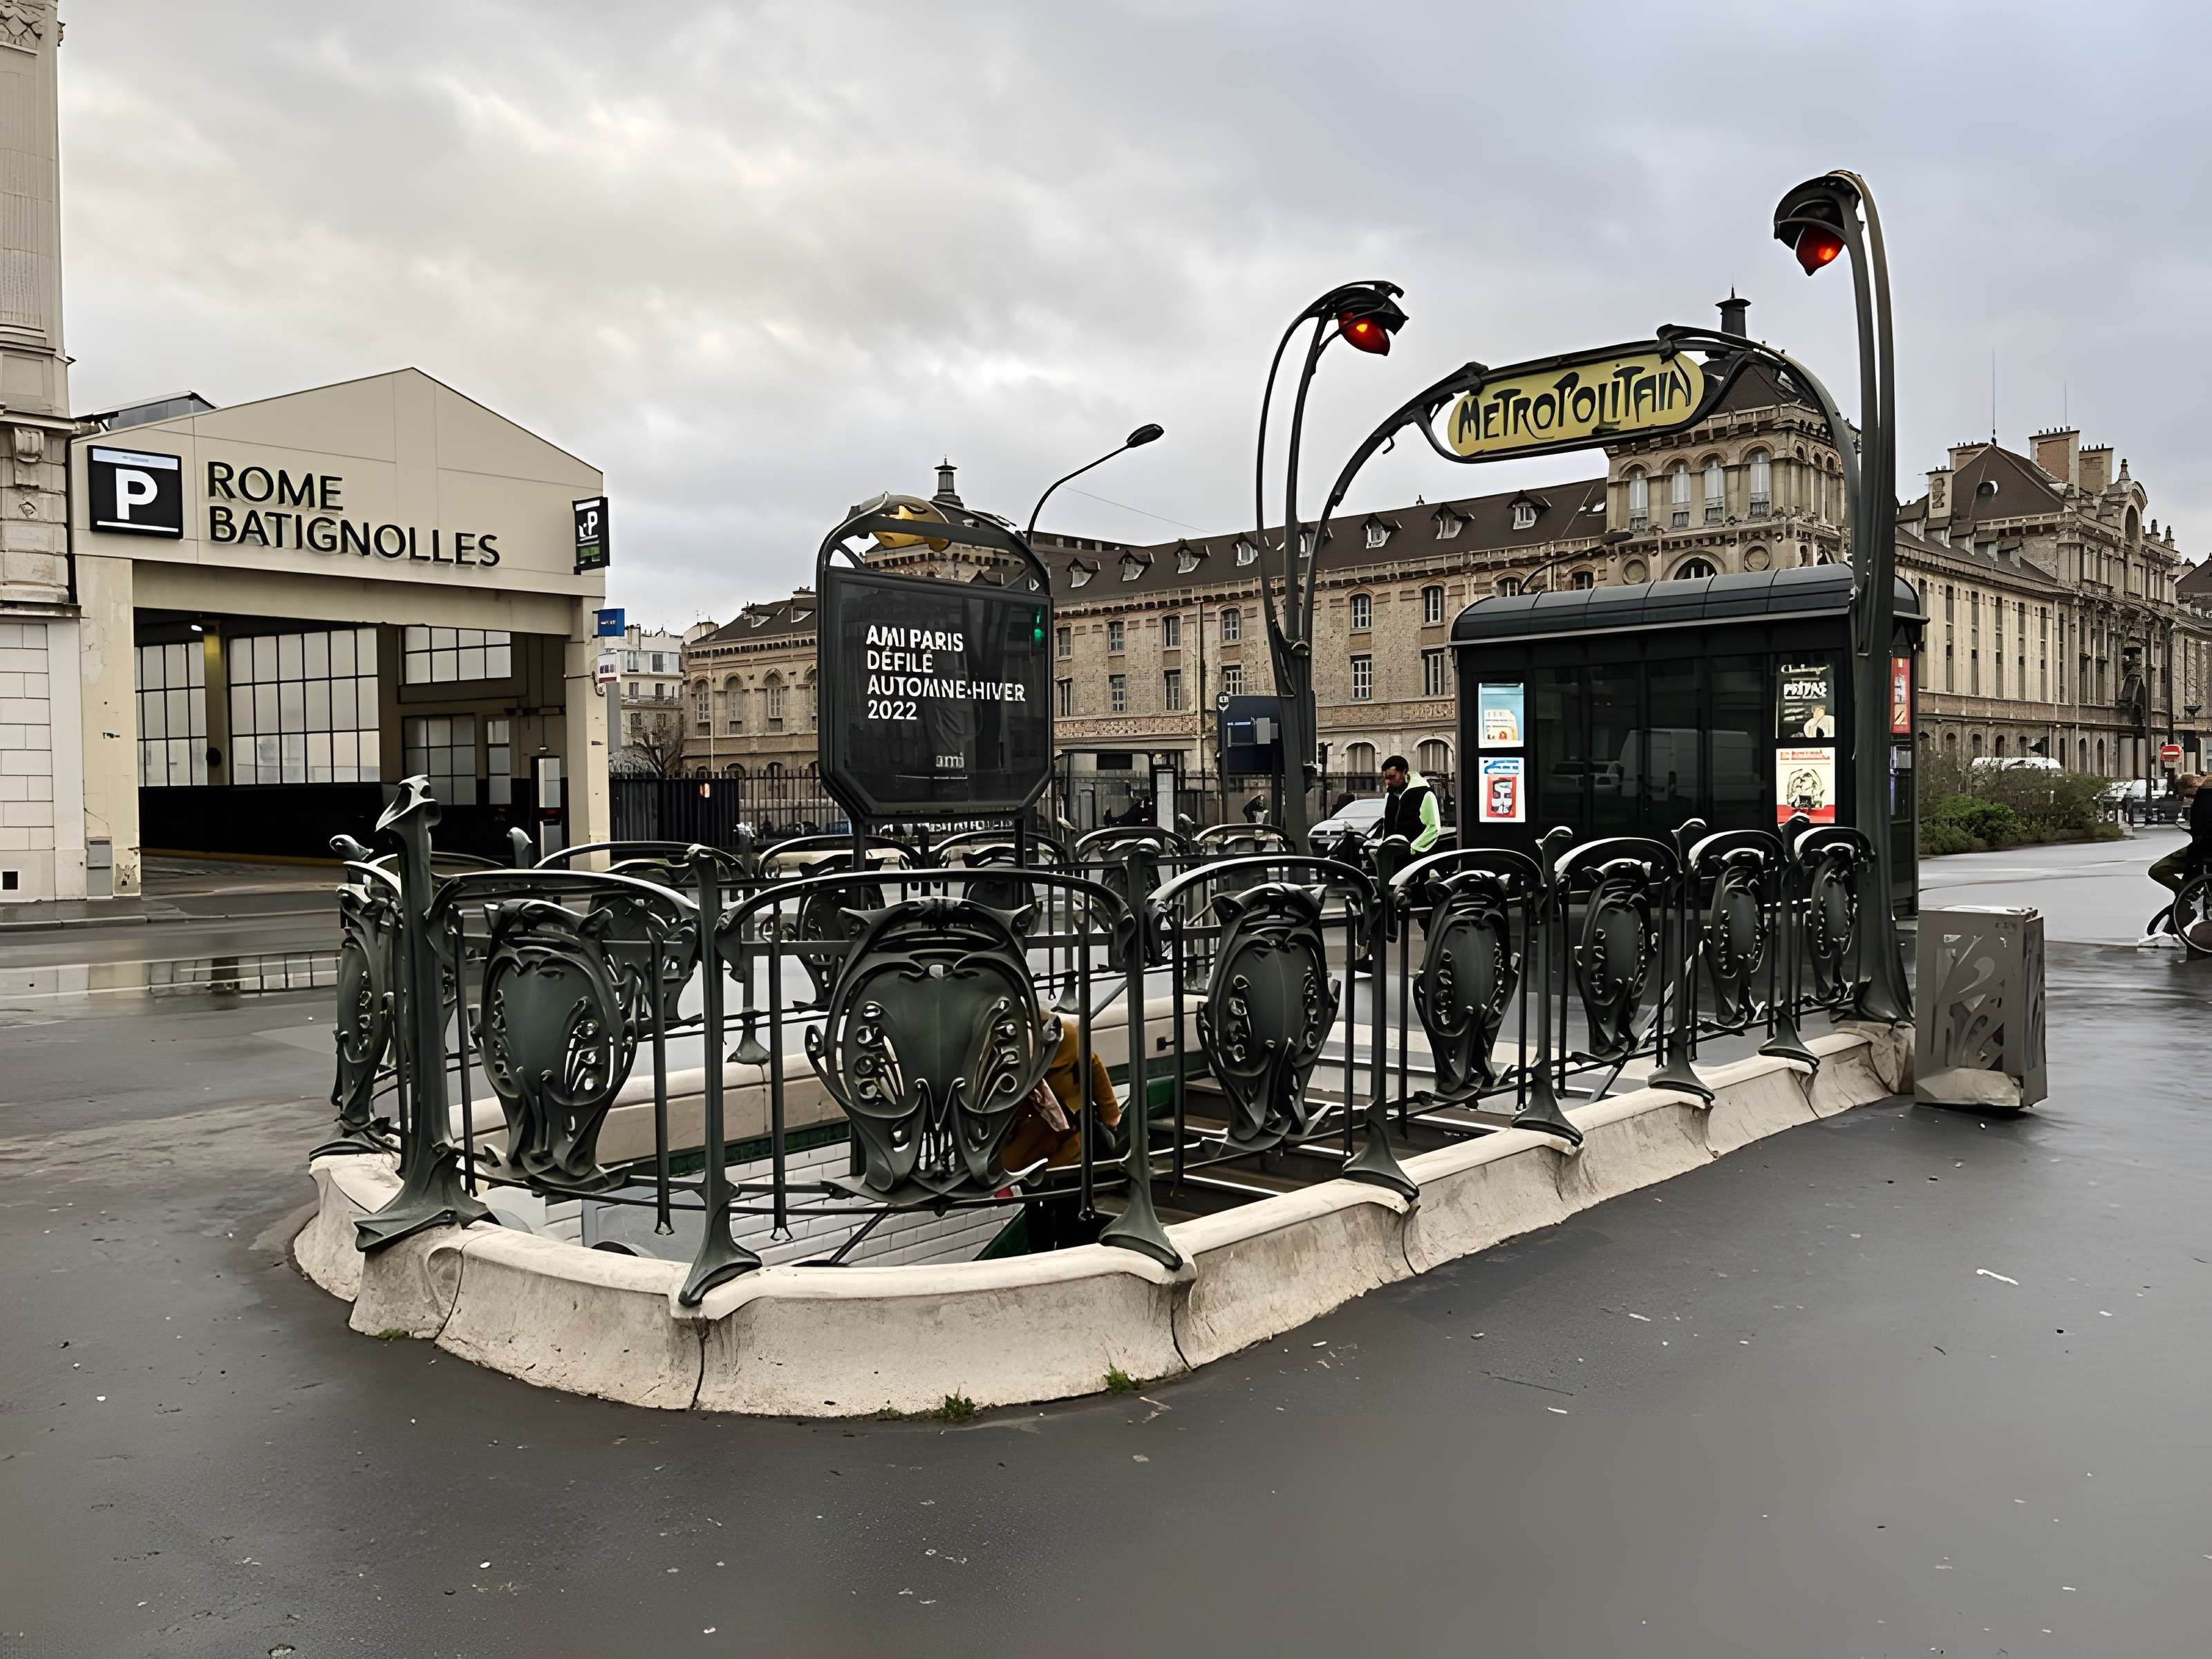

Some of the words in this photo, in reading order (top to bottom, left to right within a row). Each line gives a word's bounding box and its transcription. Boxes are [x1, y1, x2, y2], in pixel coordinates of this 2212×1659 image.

[1459, 359, 1691, 444] METROPOLITAIN
[116, 468, 158, 520] P
[207, 461, 344, 511] ROME
[210, 506, 500, 567] BATIGNOLLES
[866, 626, 905, 647] AMI
[910, 630, 964, 652] PARIS
[867, 648, 933, 673] DÉFILÉ
[868, 700, 917, 720] 2022
